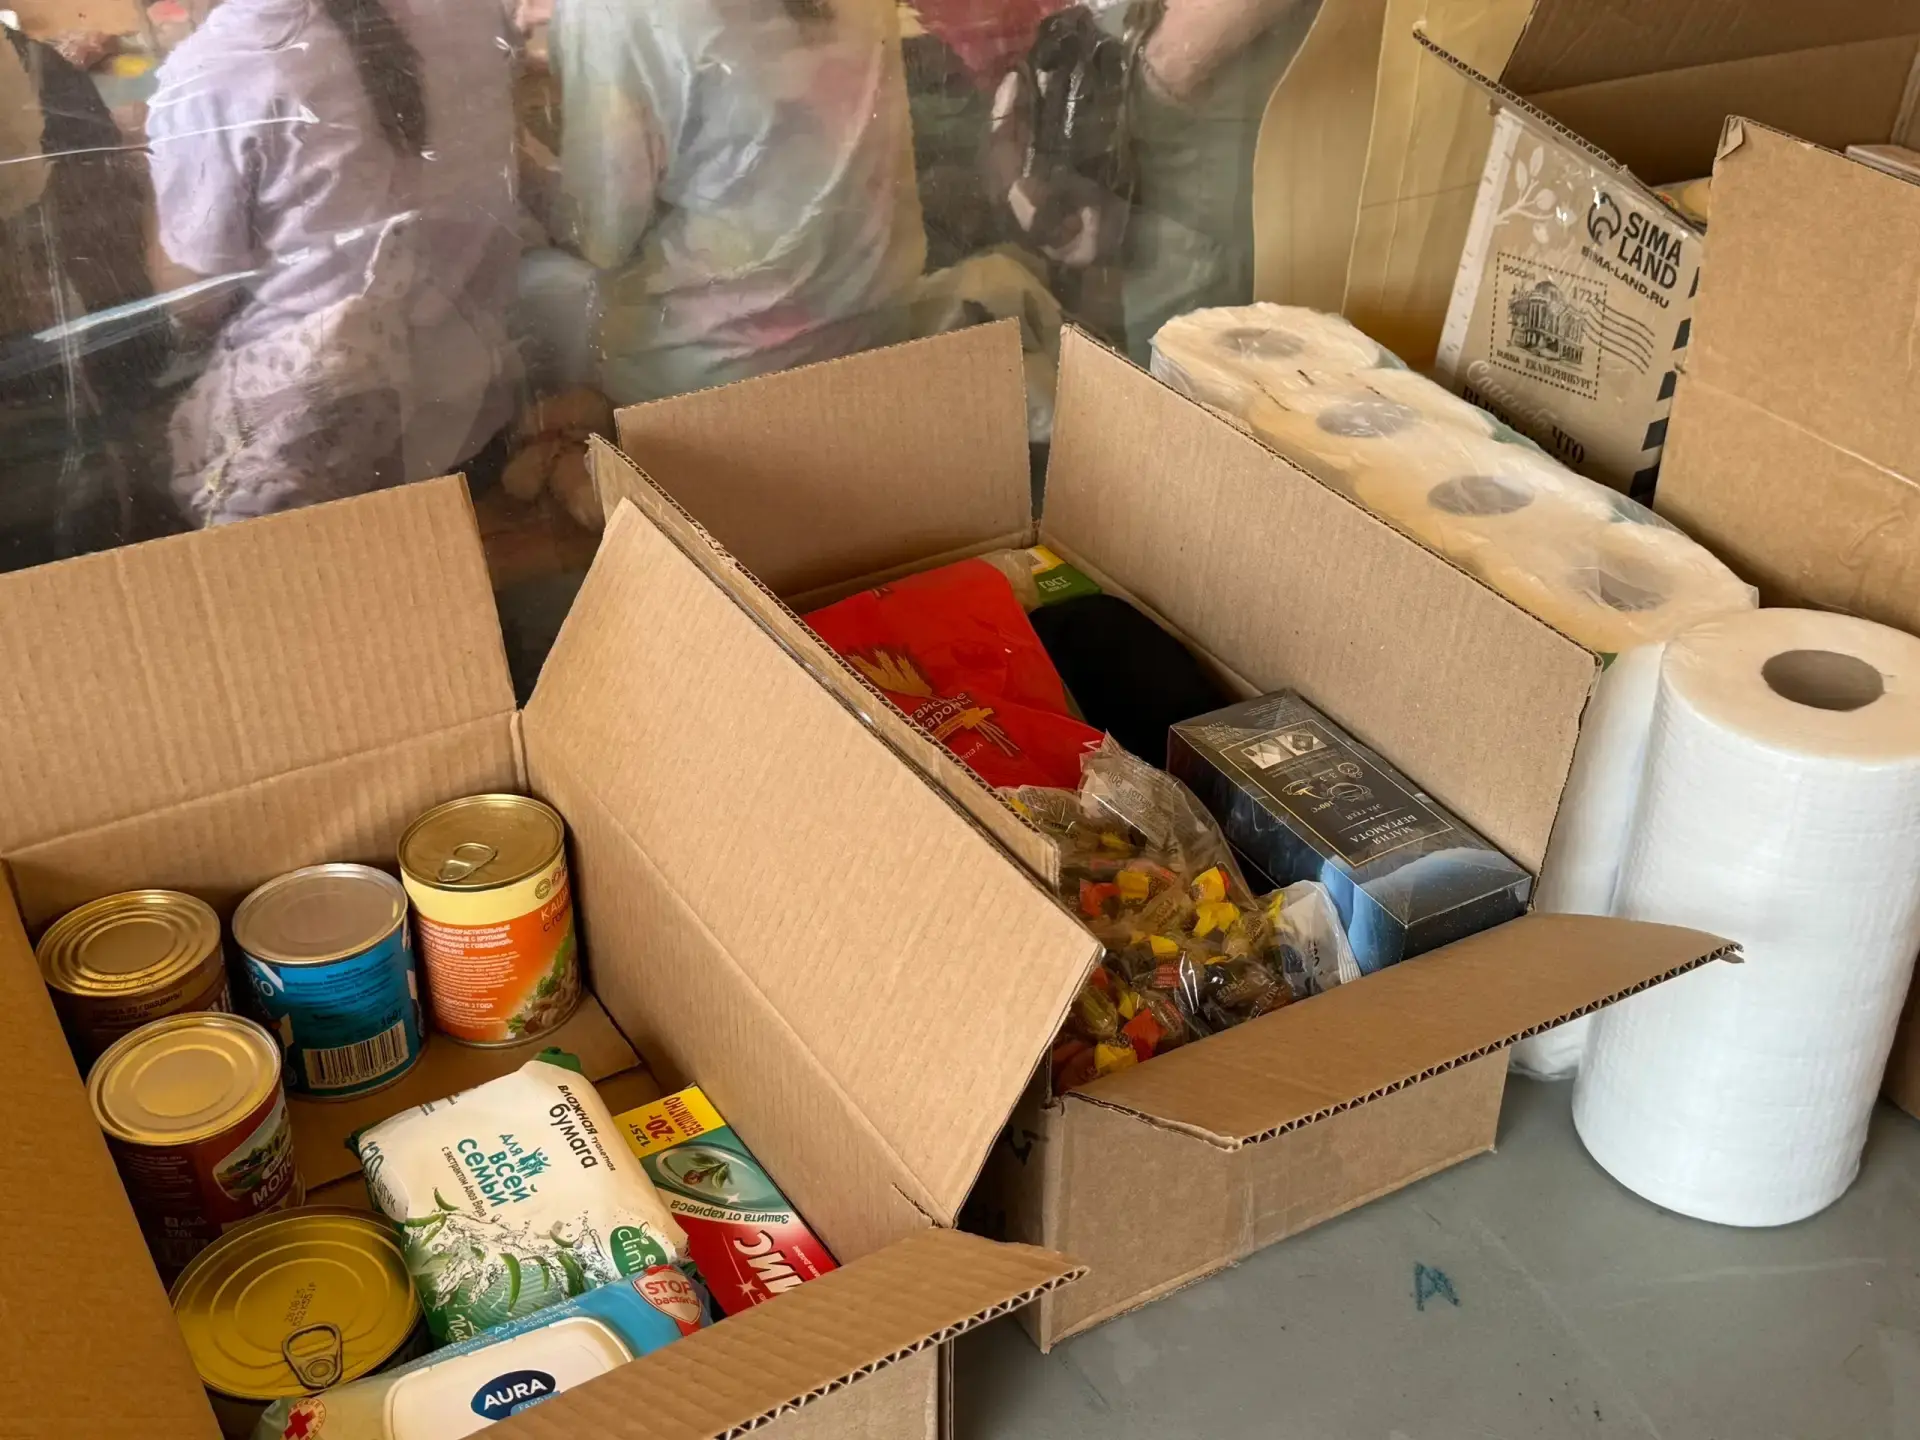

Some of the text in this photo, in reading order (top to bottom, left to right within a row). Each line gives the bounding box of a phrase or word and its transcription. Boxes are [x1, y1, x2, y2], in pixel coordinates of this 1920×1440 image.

[1624, 212, 1682, 268] SIMA
[1581, 246, 1670, 309] SIMA-LAND.RU
[1617, 235, 1677, 290] LAND
[1038, 576, 1068, 590] ГОСТ
[1349, 814, 1418, 844] БЕРГАМОТА
[1372, 827, 1416, 846] МАГИЯ
[557, 1084, 598, 1136] влажная
[662, 1096, 705, 1137] БЕСПЛАТНО
[549, 1102, 599, 1170] бумага
[629, 1122, 652, 1148] 125г
[443, 1151, 469, 1188] экстрактом
[457, 1138, 510, 1208] семьи
[487, 1150, 539, 1204] всей
[670, 1198, 790, 1225] Защита от кариеса
[617, 1228, 645, 1277] clini
[645, 1278, 692, 1296] STOP
[484, 1378, 548, 1411] AURA
